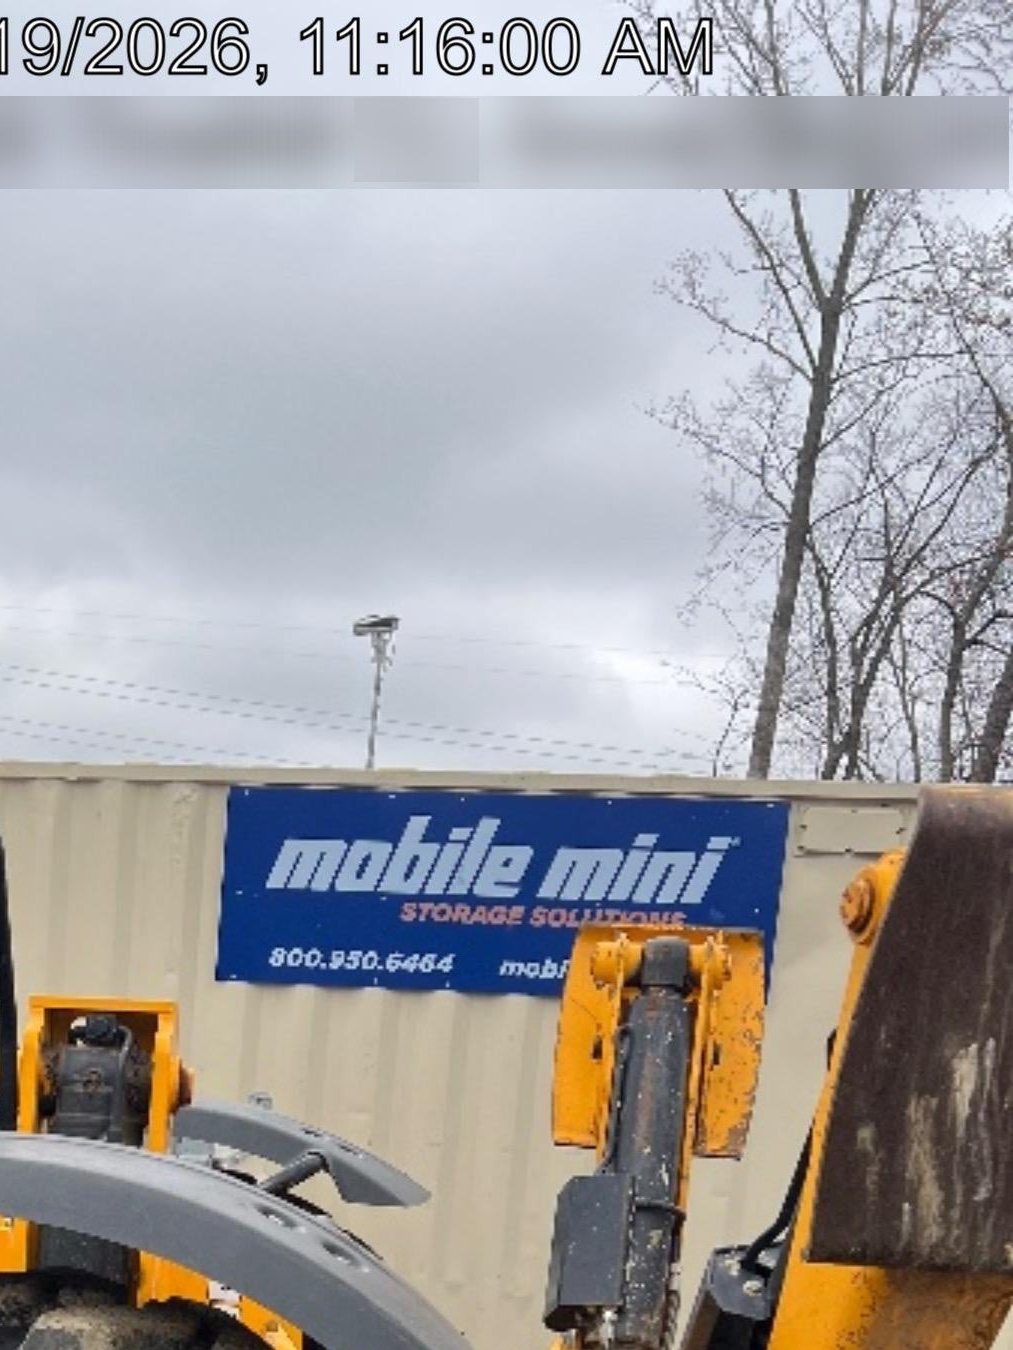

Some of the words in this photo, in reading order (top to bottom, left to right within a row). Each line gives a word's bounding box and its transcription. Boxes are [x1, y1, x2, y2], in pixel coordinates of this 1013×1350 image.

[265, 814, 534, 899] mobile
[535, 832, 730, 905] mini
[400, 902, 526, 926] STORAGE
[268, 947, 456, 974] 800.950.6464
